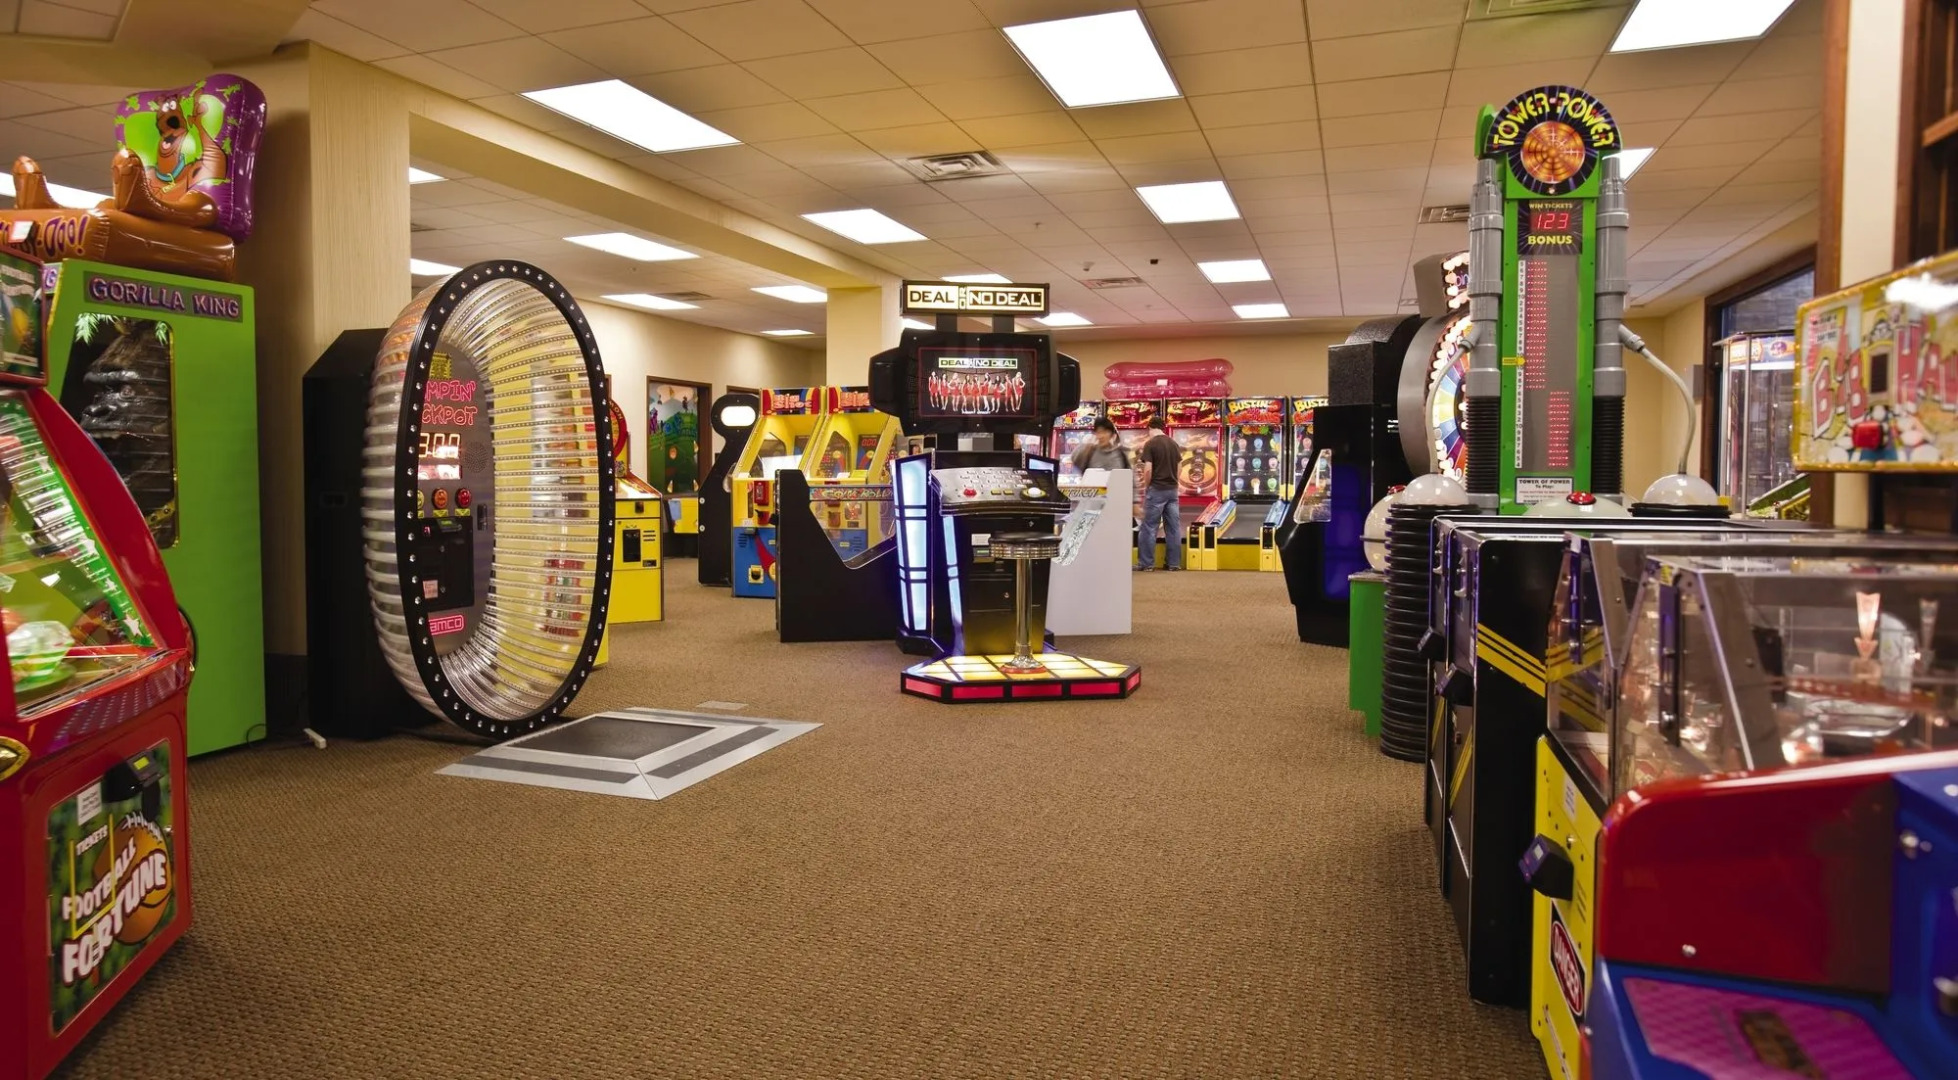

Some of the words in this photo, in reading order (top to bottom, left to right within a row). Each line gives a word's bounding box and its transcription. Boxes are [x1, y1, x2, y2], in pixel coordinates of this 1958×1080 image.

[1493, 92, 1551, 146] TOWER
[1556, 92, 1615, 148] POWER
[1537, 212, 1569, 229] 123
[1527, 235, 1573, 245] BONUS
[89, 277, 186, 312] GORILLA
[193, 293, 241, 319] KING
[909, 290, 956, 304] DEAL
[969, 291, 994, 306] NO
[996, 292, 1042, 307] DEAL
[421, 403, 478, 426] CKPOT
[1294, 399, 1329, 413] BUSTI
[76, 824, 108, 856] TICKETS
[61, 836, 137, 921] FOOTBALL
[61, 850, 168, 985] FORTUNE
[1553, 925, 1581, 1010] DANGER
